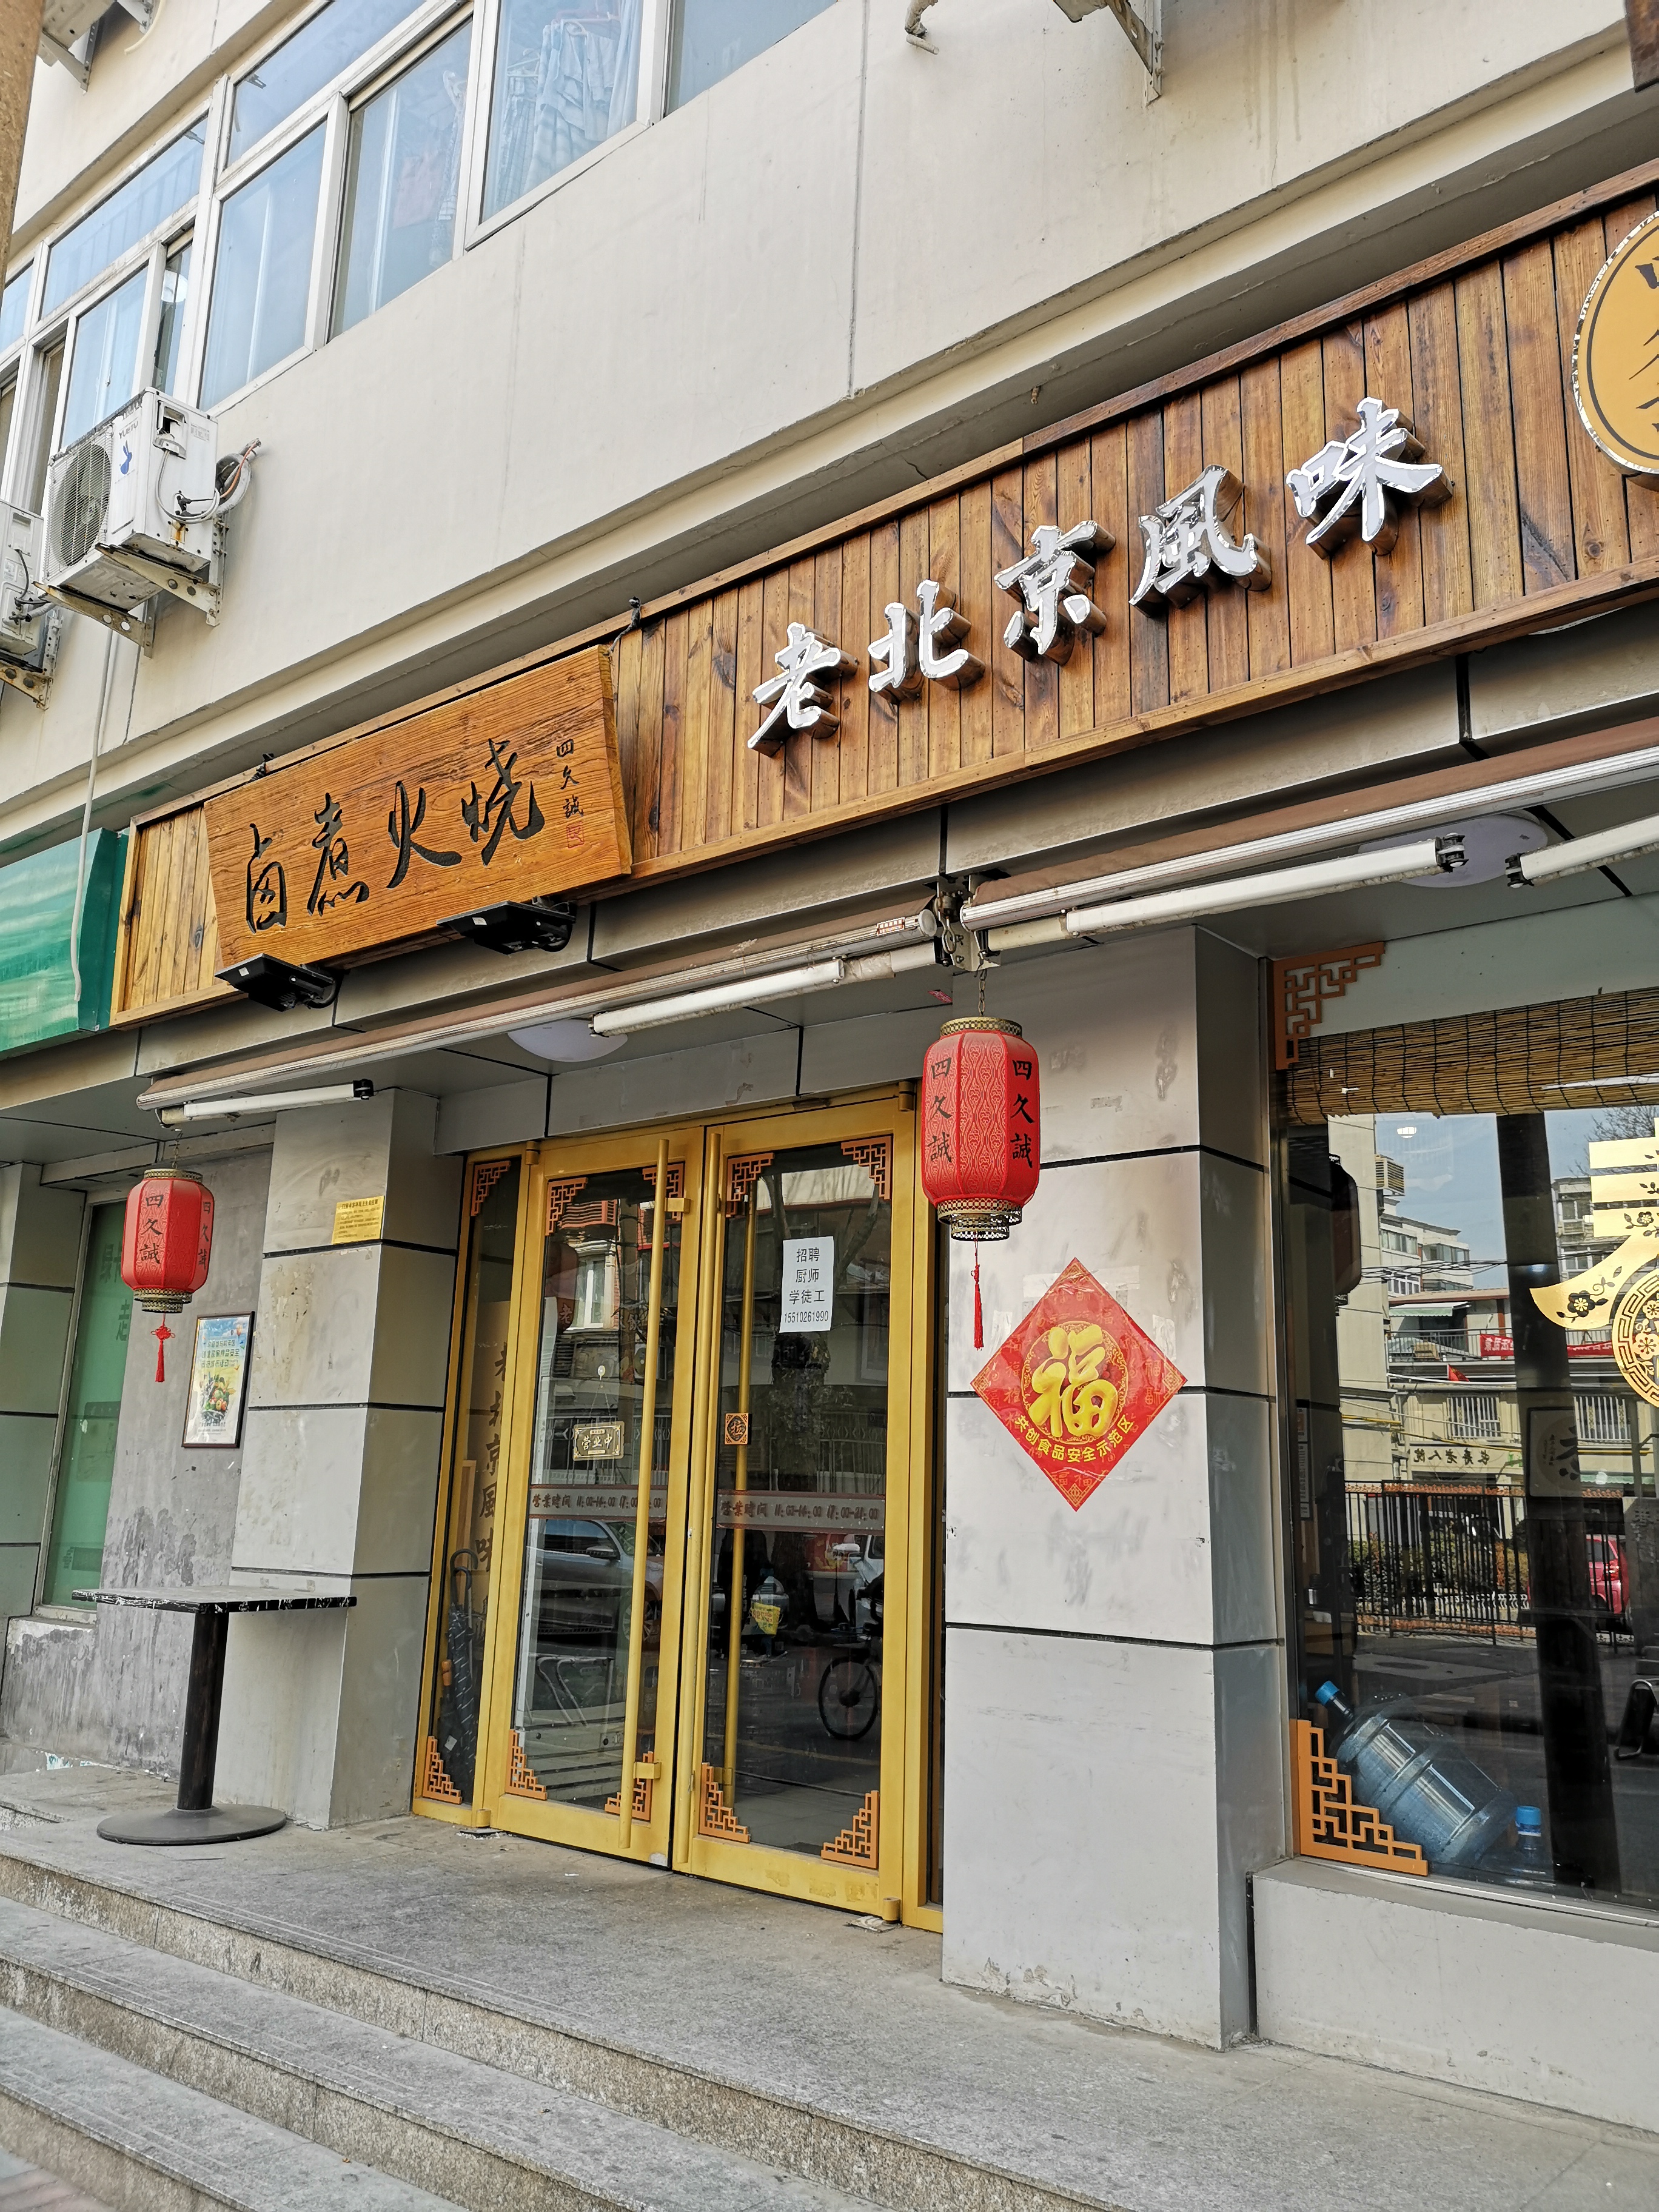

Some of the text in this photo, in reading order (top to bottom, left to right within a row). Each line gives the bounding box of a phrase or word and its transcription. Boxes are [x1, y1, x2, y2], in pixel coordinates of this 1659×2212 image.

[747, 395, 1444, 751] 老北京風味
[927, 1057, 953, 1164] 四久誠
[1010, 1058, 1035, 1168] 四久誠
[139, 1194, 164, 1265] 四久誠
[796, 1247, 820, 1262] 招聘
[796, 1268, 820, 1283] 厨师
[789, 1289, 825, 1305] 学徒工
[784, 1310, 830, 1323] 15510261990
[1028, 1324, 1119, 1438] 福
[581, 1433, 613, 1450] 营业中
[1014, 1414, 1134, 1464] 共创食品安全示范区
[619, 1495, 662, 1509] 17:00:00
